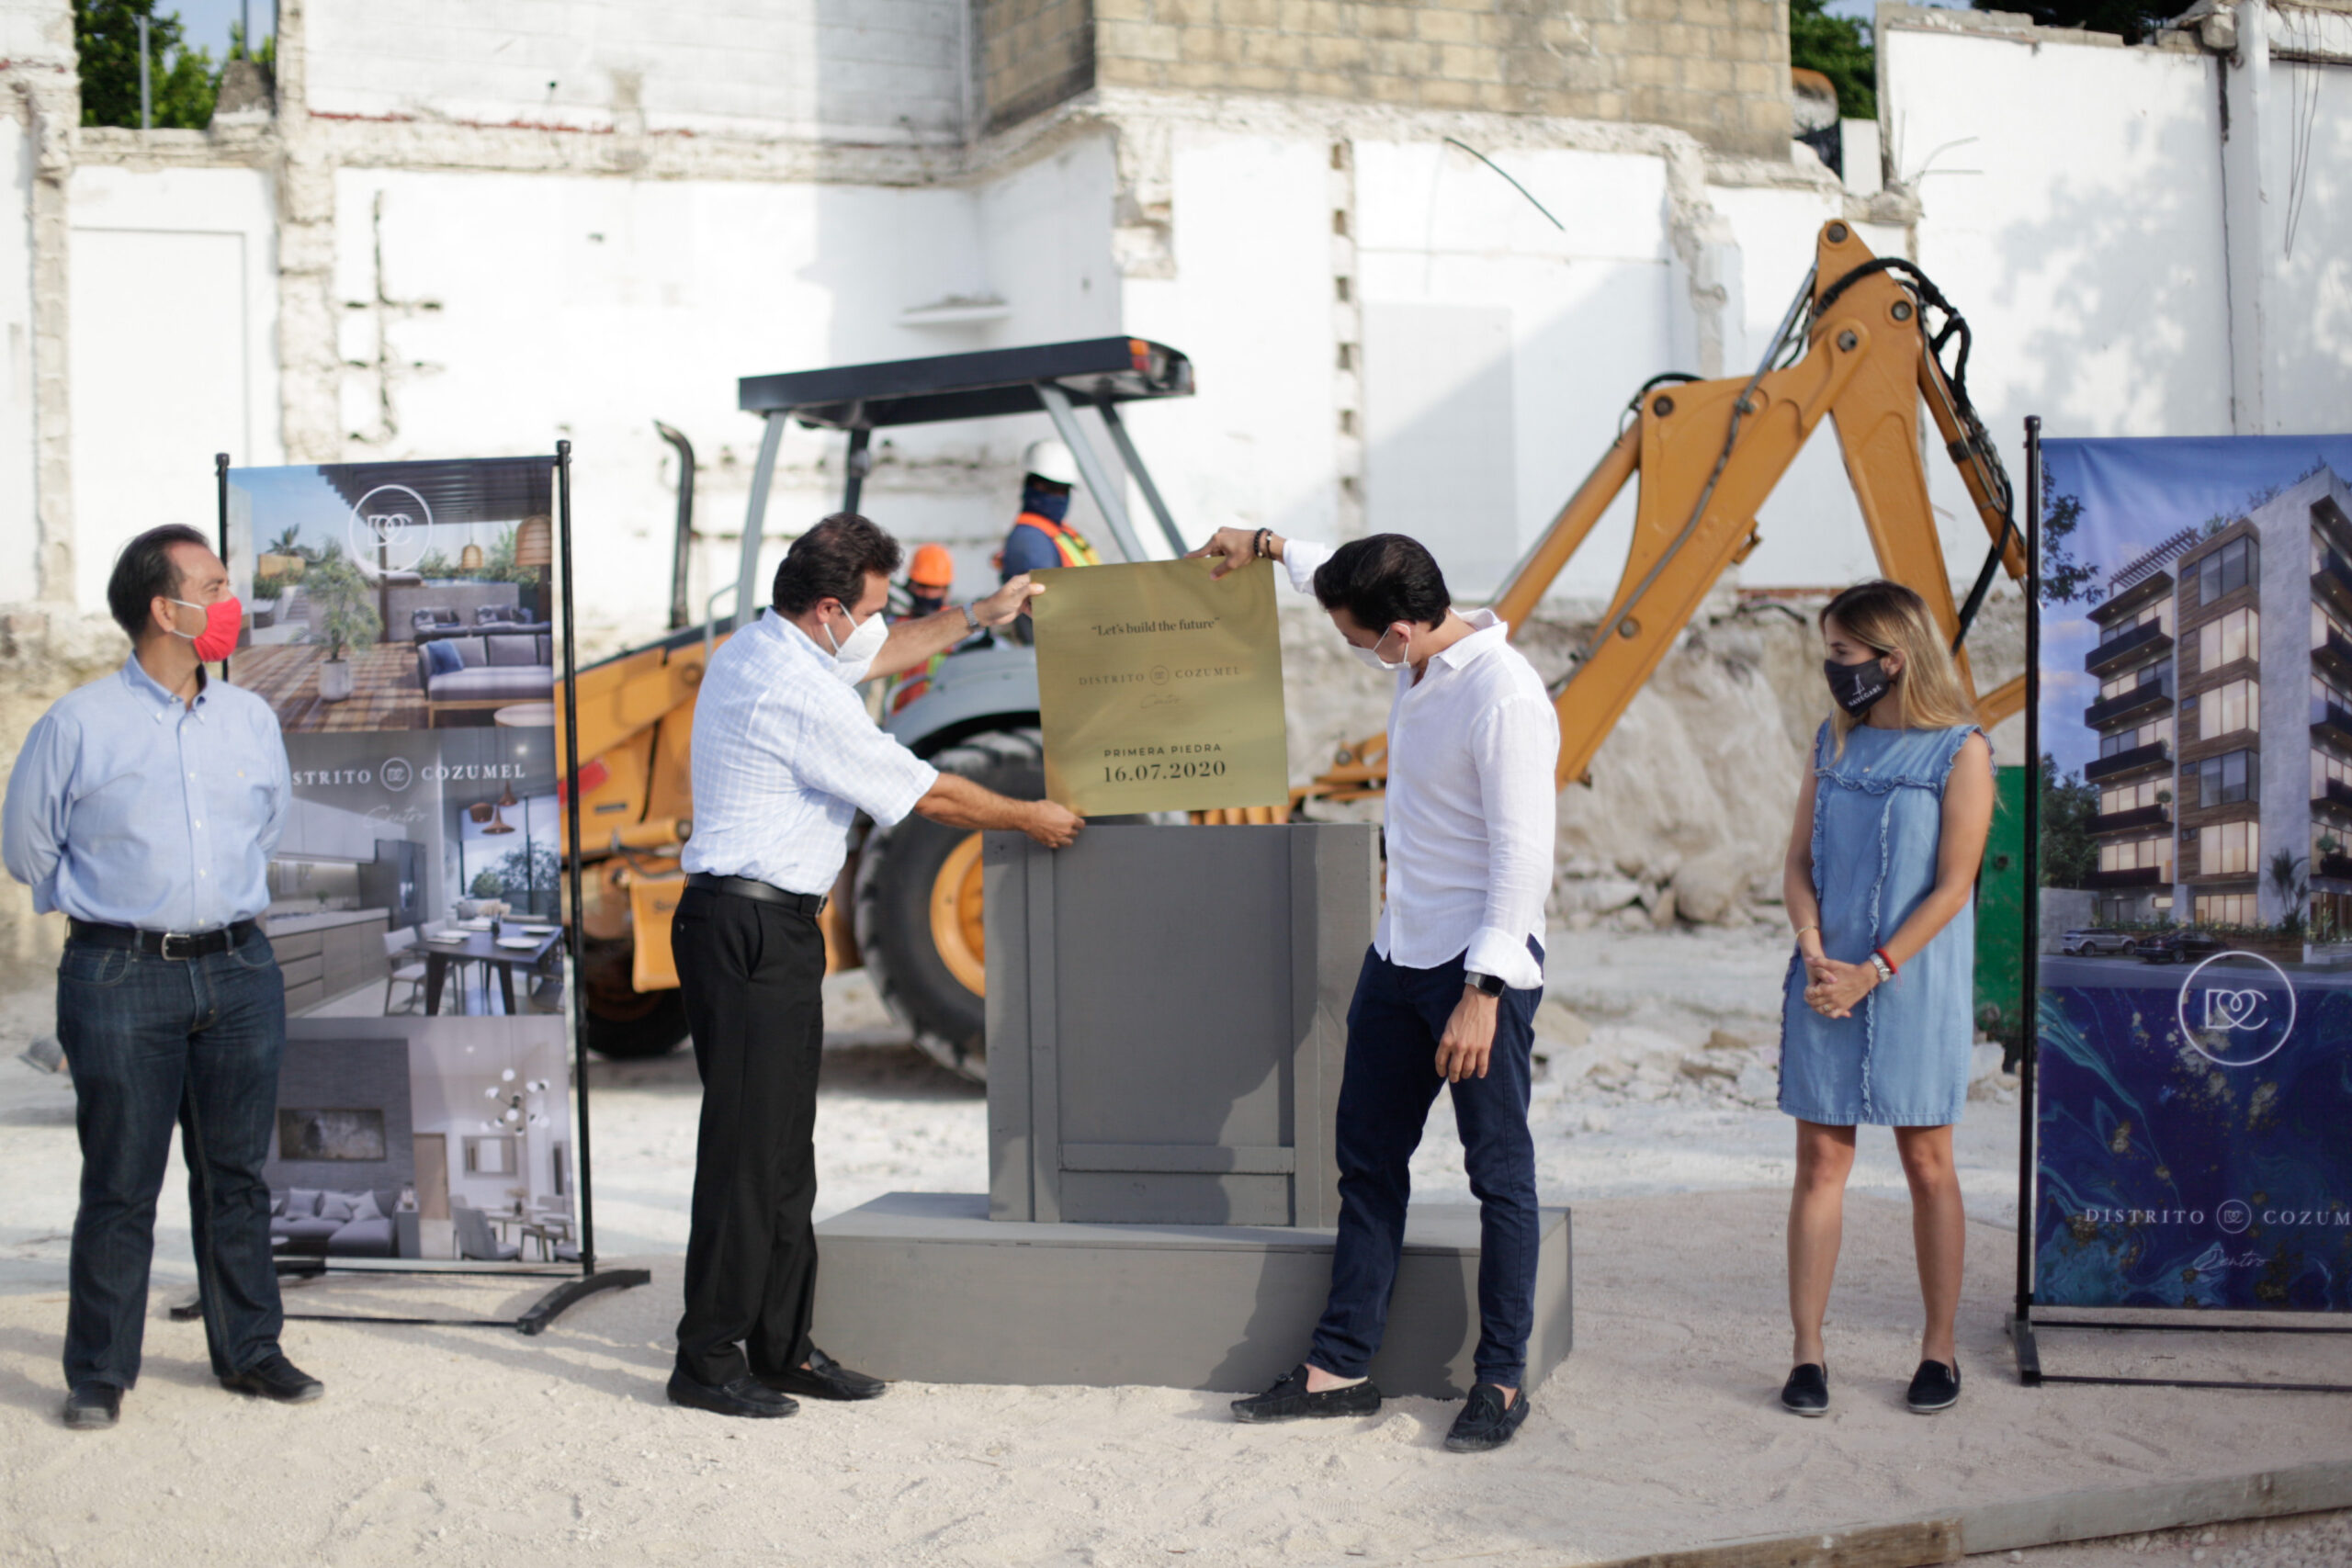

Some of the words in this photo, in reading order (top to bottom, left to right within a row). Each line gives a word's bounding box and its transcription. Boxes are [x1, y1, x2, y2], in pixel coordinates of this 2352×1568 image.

[1125, 620, 1156, 634] build
[1158, 619, 1177, 632] the
[1079, 673, 1145, 685] DISTRITO
[1175, 666, 1239, 679] COZUMEL
[1103, 746, 1165, 757] PRIMERA
[1170, 743, 1222, 753] PIEDRA
[292, 770, 371, 785] STRITO
[421, 763, 526, 780] COZUMEL
[1103, 761, 1226, 783] 16.07.2020
[2086, 1208, 2204, 1224] DISTRITO
[2263, 1210, 2351, 1226] COZUM
[2192, 1248, 2270, 1271] Centro
